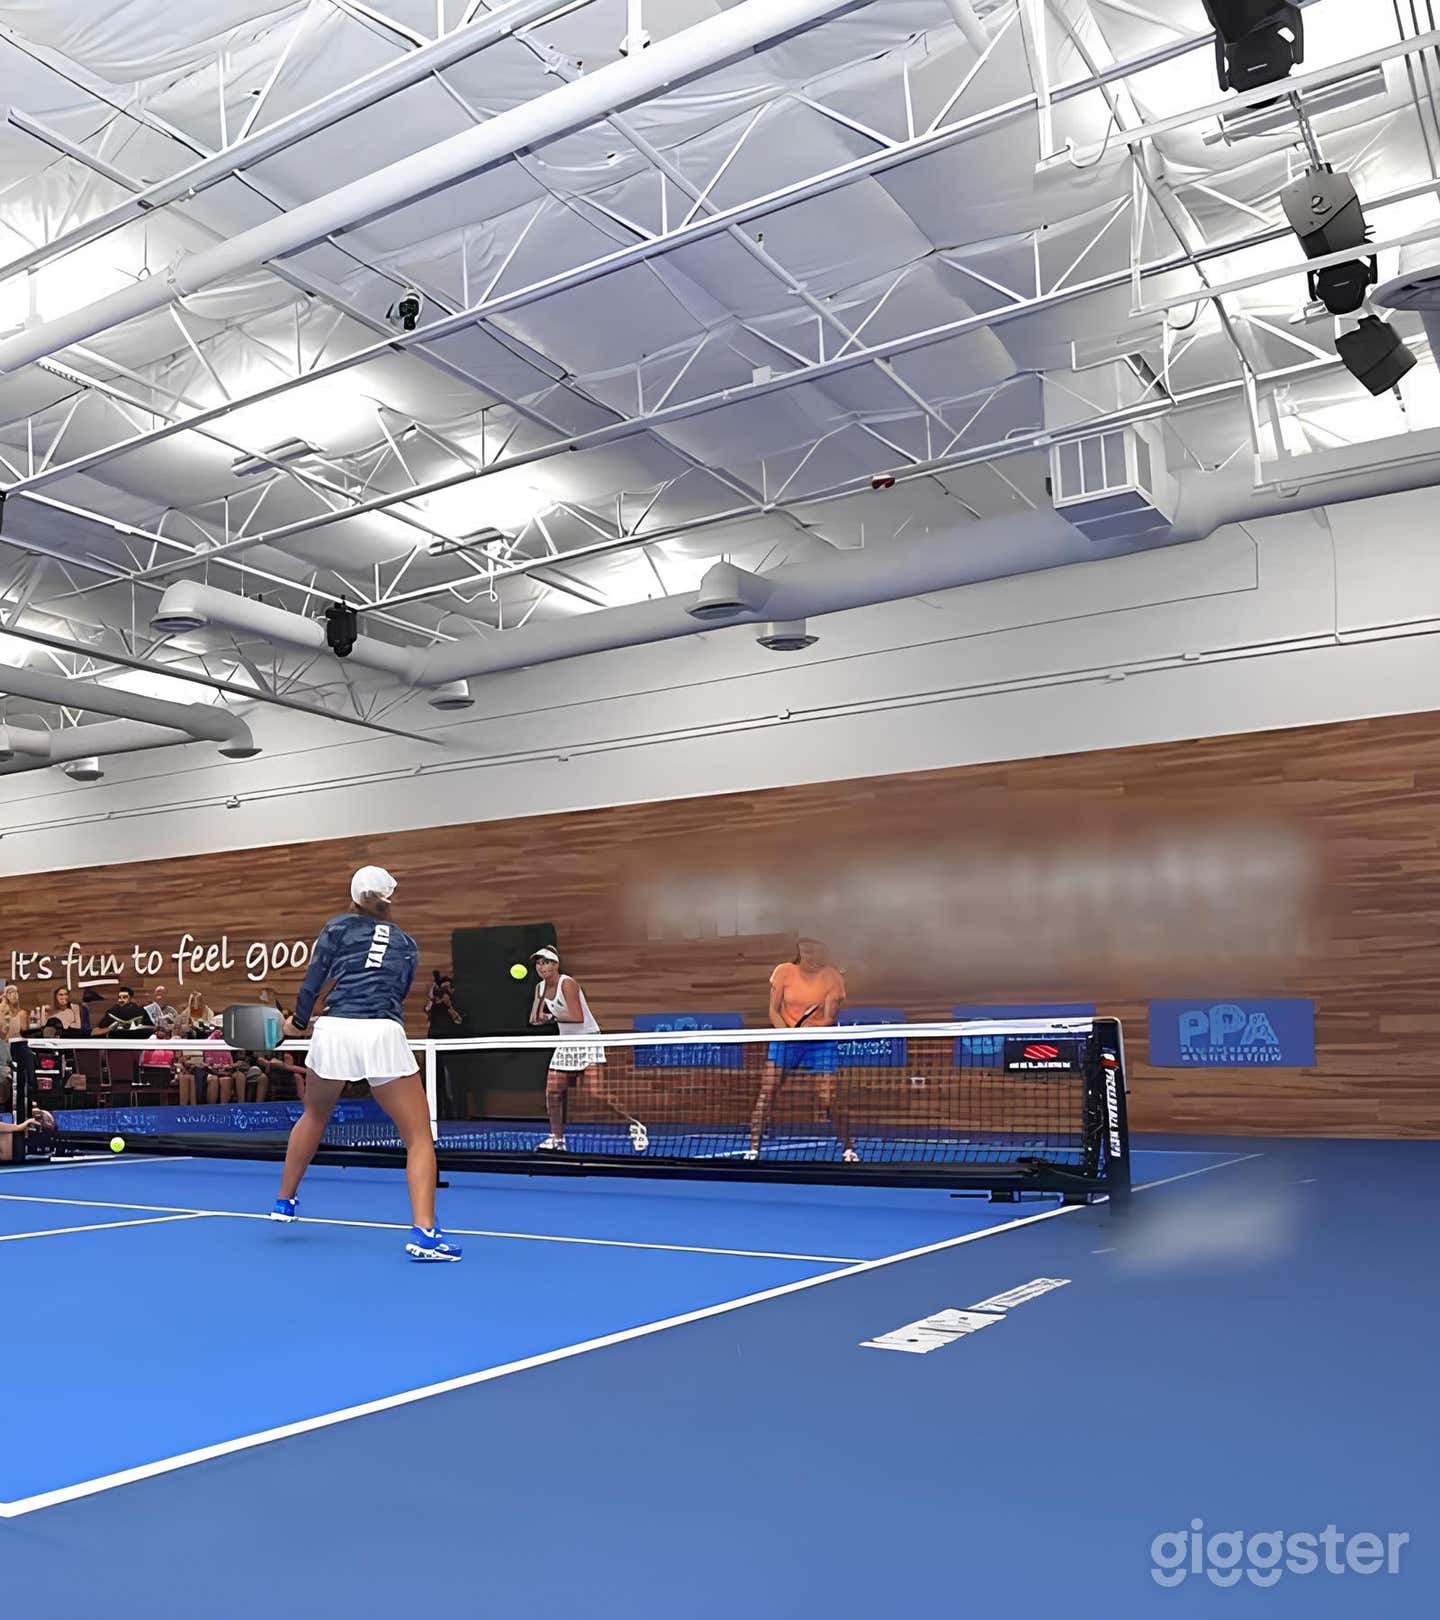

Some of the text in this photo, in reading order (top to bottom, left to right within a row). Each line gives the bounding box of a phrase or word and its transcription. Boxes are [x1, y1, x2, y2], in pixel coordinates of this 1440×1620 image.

[11, 950, 53, 980] It's
[61, 942, 125, 991] fun
[132, 944, 162, 975] to
[171, 933, 235, 985] feel
[246, 938, 319, 981] goo
[1179, 1003, 1279, 1046] PPA
